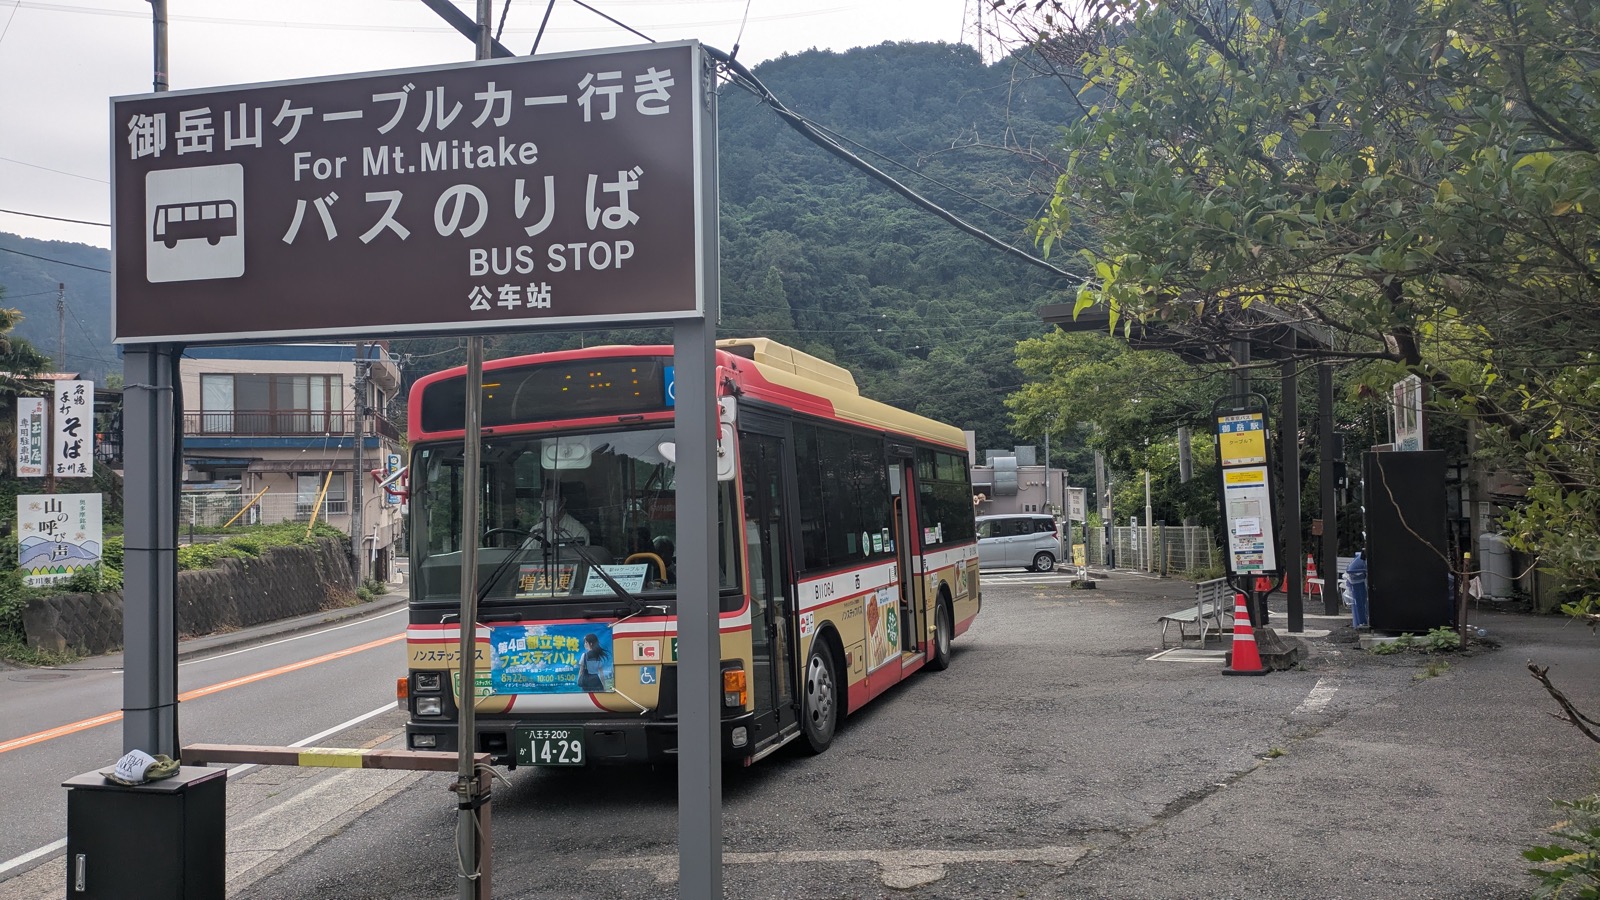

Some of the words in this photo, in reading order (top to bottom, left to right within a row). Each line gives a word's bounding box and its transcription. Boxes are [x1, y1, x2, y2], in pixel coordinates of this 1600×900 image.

[127, 66, 675, 159] 御岳山ケーブルカー行き
[293, 151, 347, 182] For
[362, 137, 539, 177] Mt.Mitake
[281, 165, 644, 245] バスのりば
[469, 246, 534, 276] BUS
[547, 240, 635, 273] STOP
[467, 282, 552, 311] 公车站
[19, 418, 30, 464] 専用駐車場
[31, 421, 42, 462] 玉川屋
[62, 416, 84, 459] そば
[1221, 421, 1260, 433] 御岳駅
[38, 498, 69, 561] 山の呼び声
[518, 574, 573, 591] 増発便
[814, 581, 835, 600] B11064
[805, 613, 813, 626] 出口
[841, 605, 863, 621] ノンステップバス
[413, 649, 484, 661] ノンステッス
[500, 651, 578, 669] フェスティバル
[519, 747, 527, 756] か
[531, 740, 582, 763] 14-29
